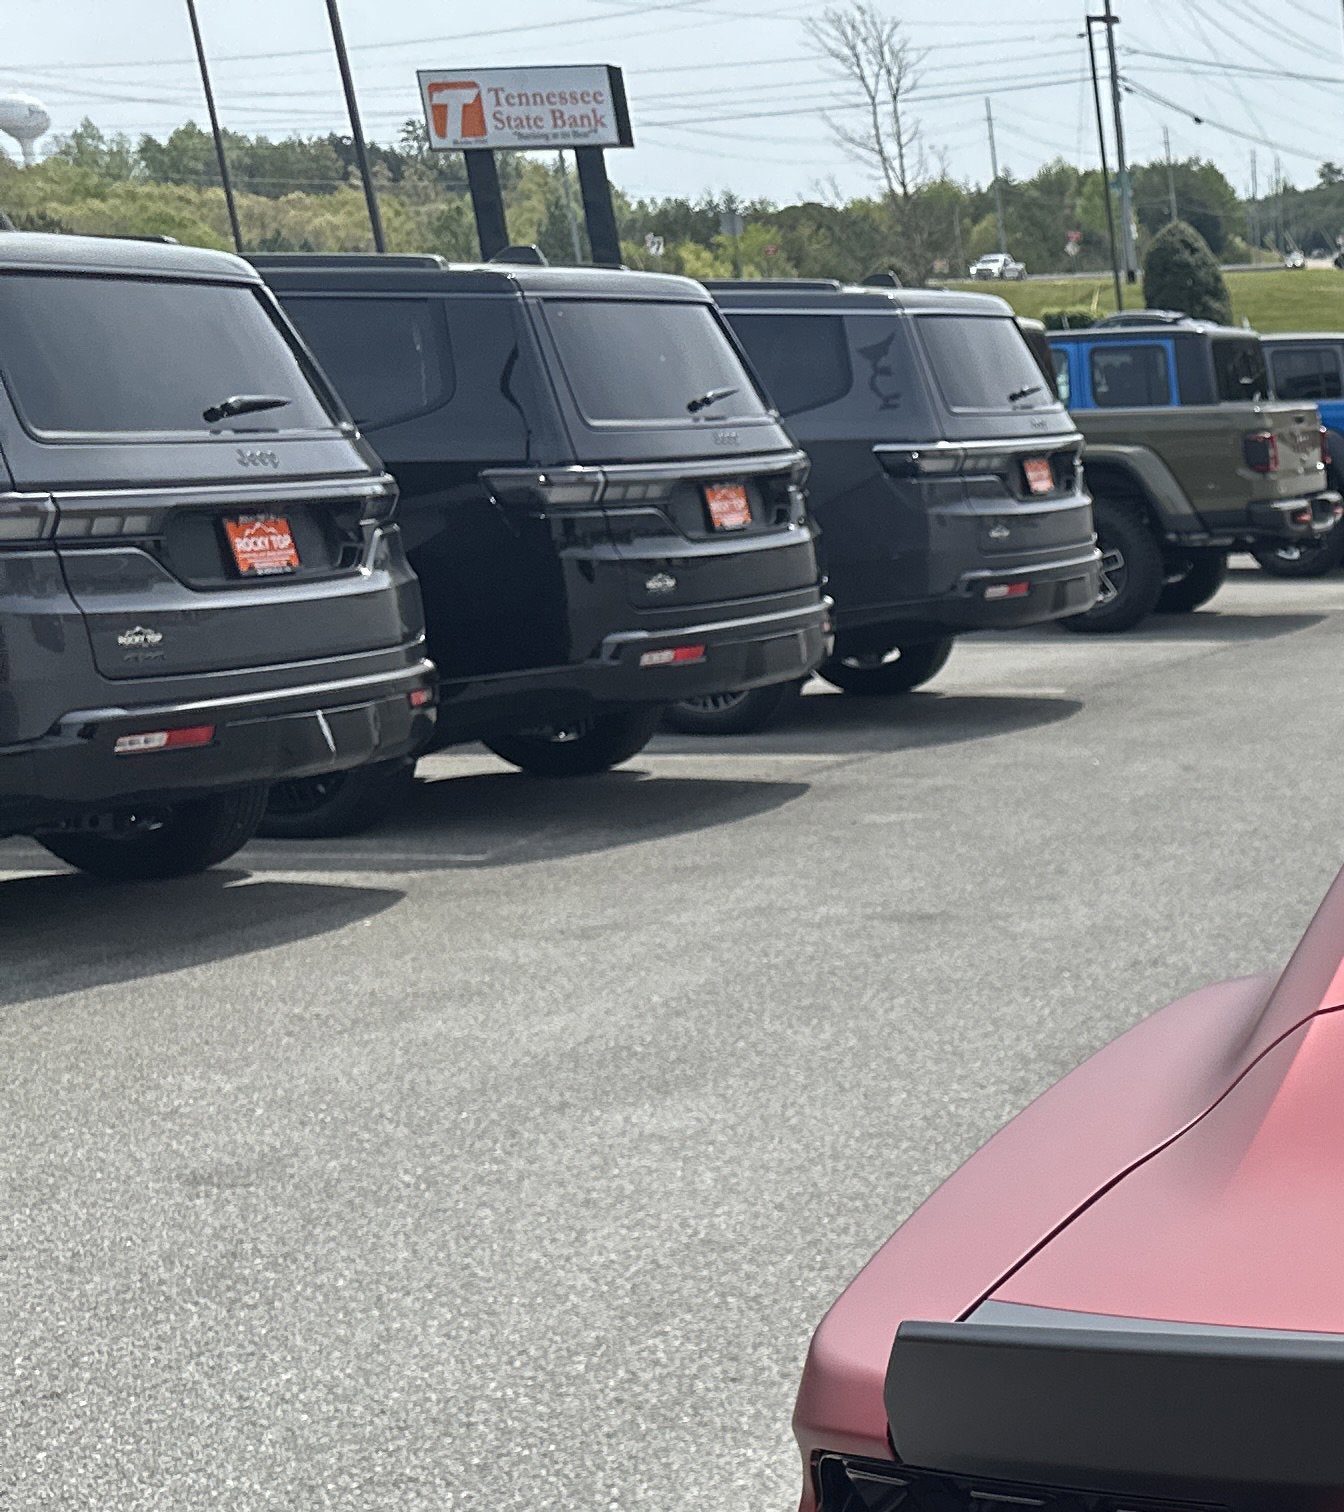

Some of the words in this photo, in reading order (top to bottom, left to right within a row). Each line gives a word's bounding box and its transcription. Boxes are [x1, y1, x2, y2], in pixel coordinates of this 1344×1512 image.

[488, 86, 604, 107] Tennessee
[492, 110, 544, 130] State
[550, 108, 608, 130] Bank
